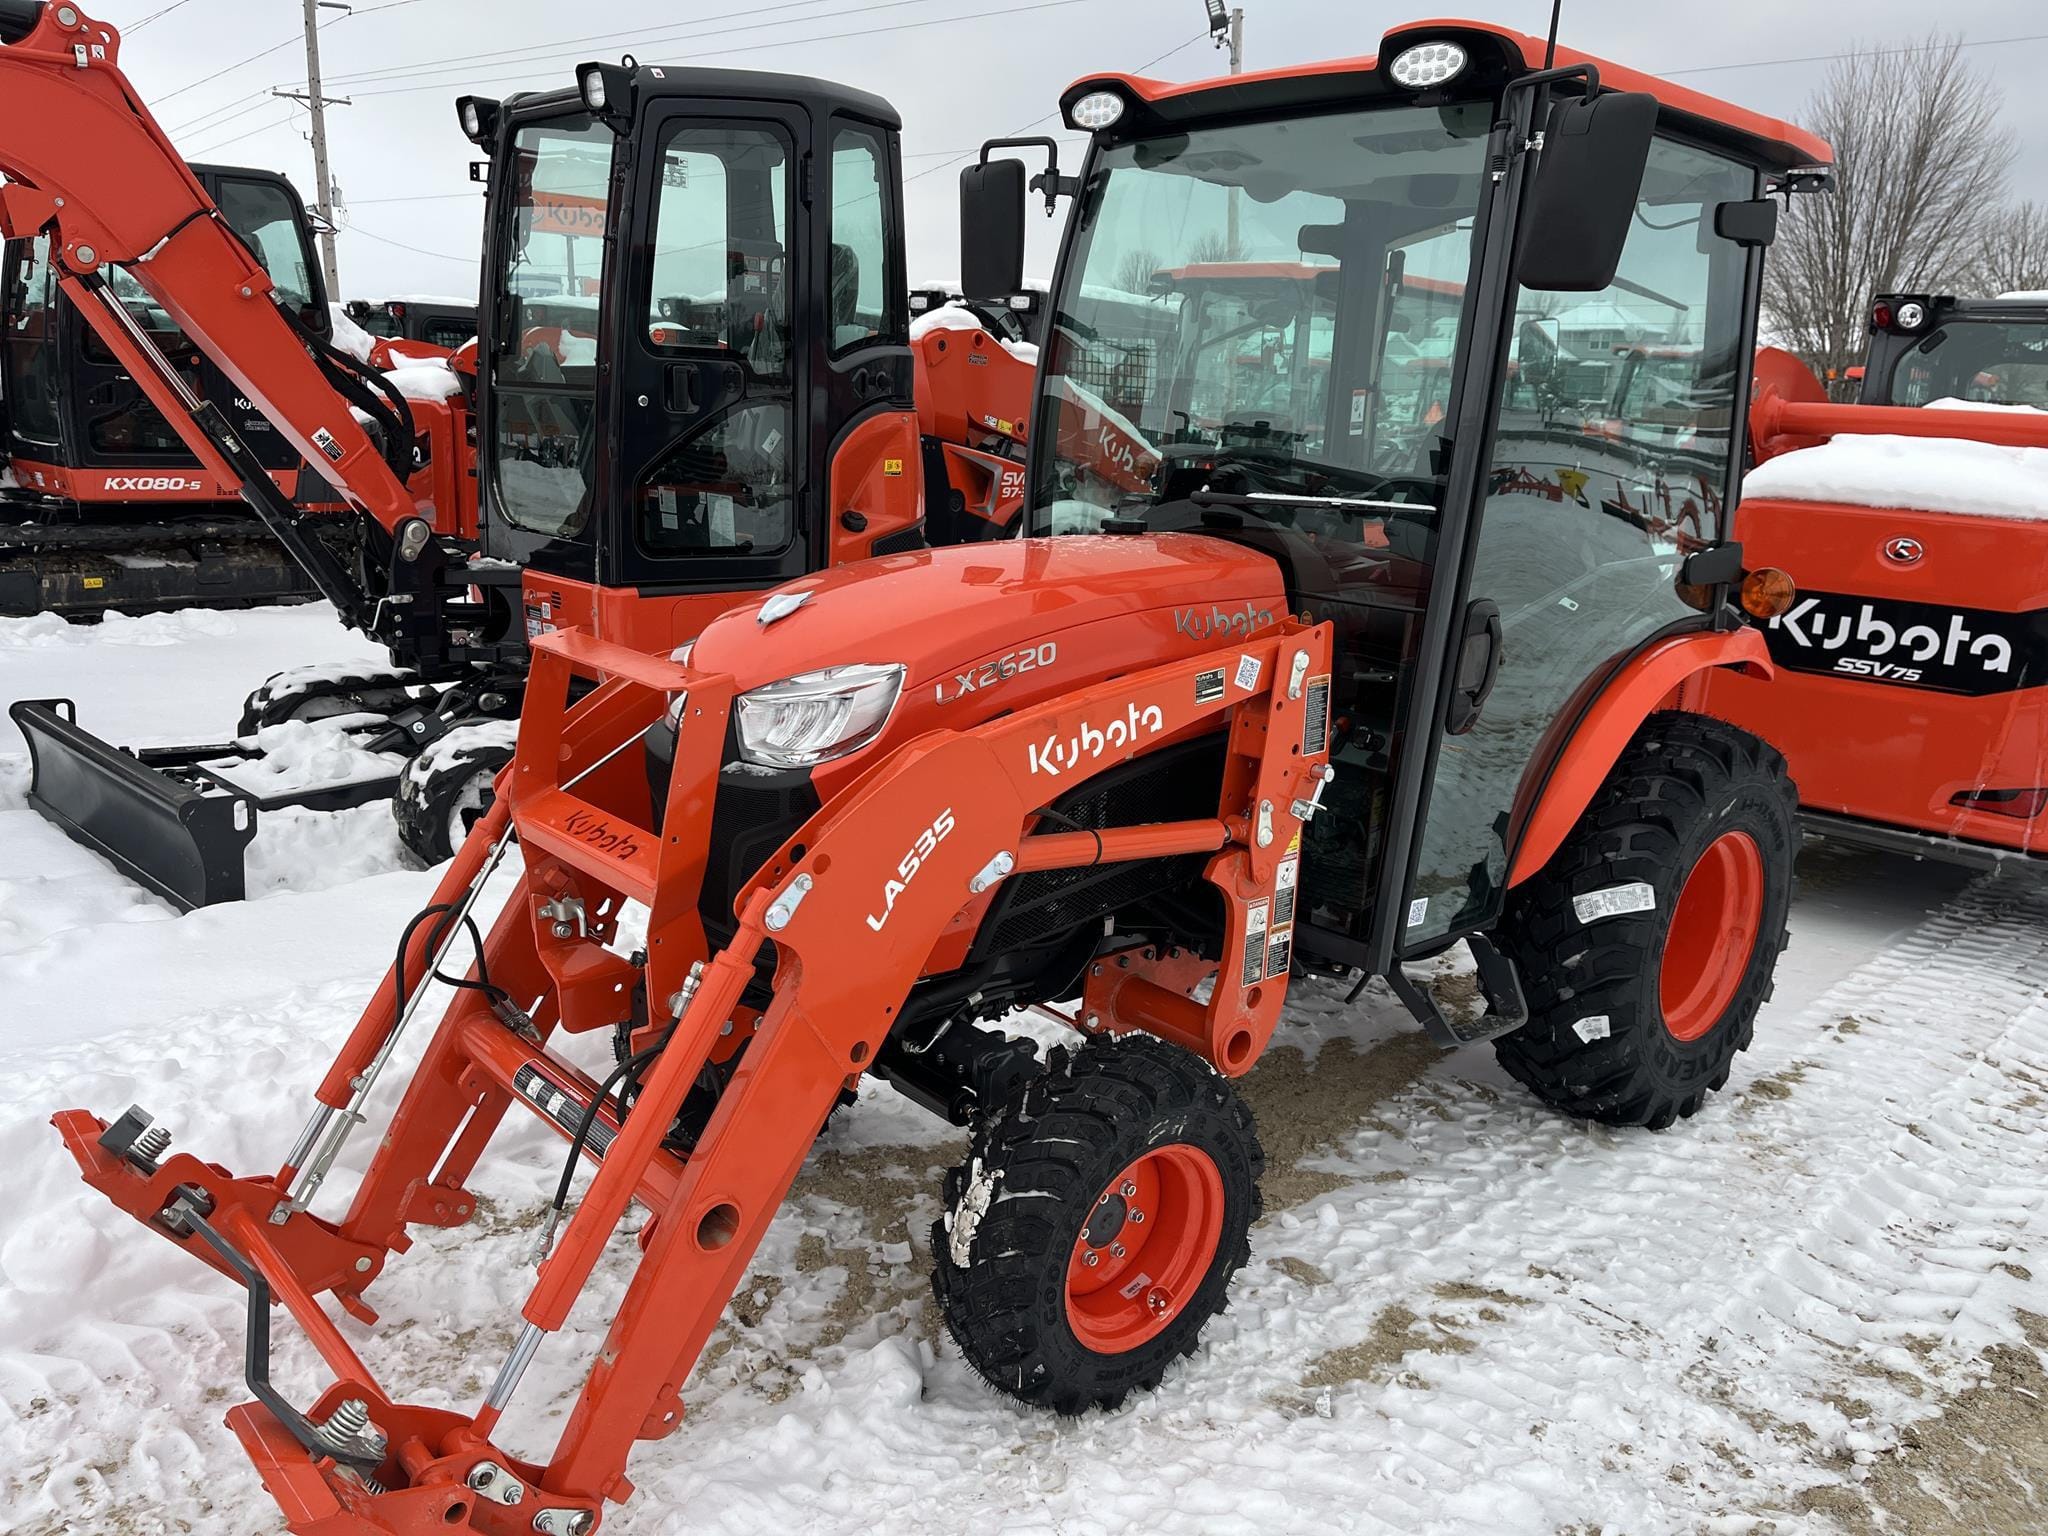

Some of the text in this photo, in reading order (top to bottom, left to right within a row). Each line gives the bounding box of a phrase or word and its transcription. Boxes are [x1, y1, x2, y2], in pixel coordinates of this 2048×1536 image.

[1174, 602, 1274, 640] Kubota
[1768, 598, 2013, 674] Kubota
[935, 642, 1057, 706] LX2620
[1028, 702, 1164, 776] Kubota
[565, 810, 638, 860] Kubota
[866, 807, 955, 931] LA535
